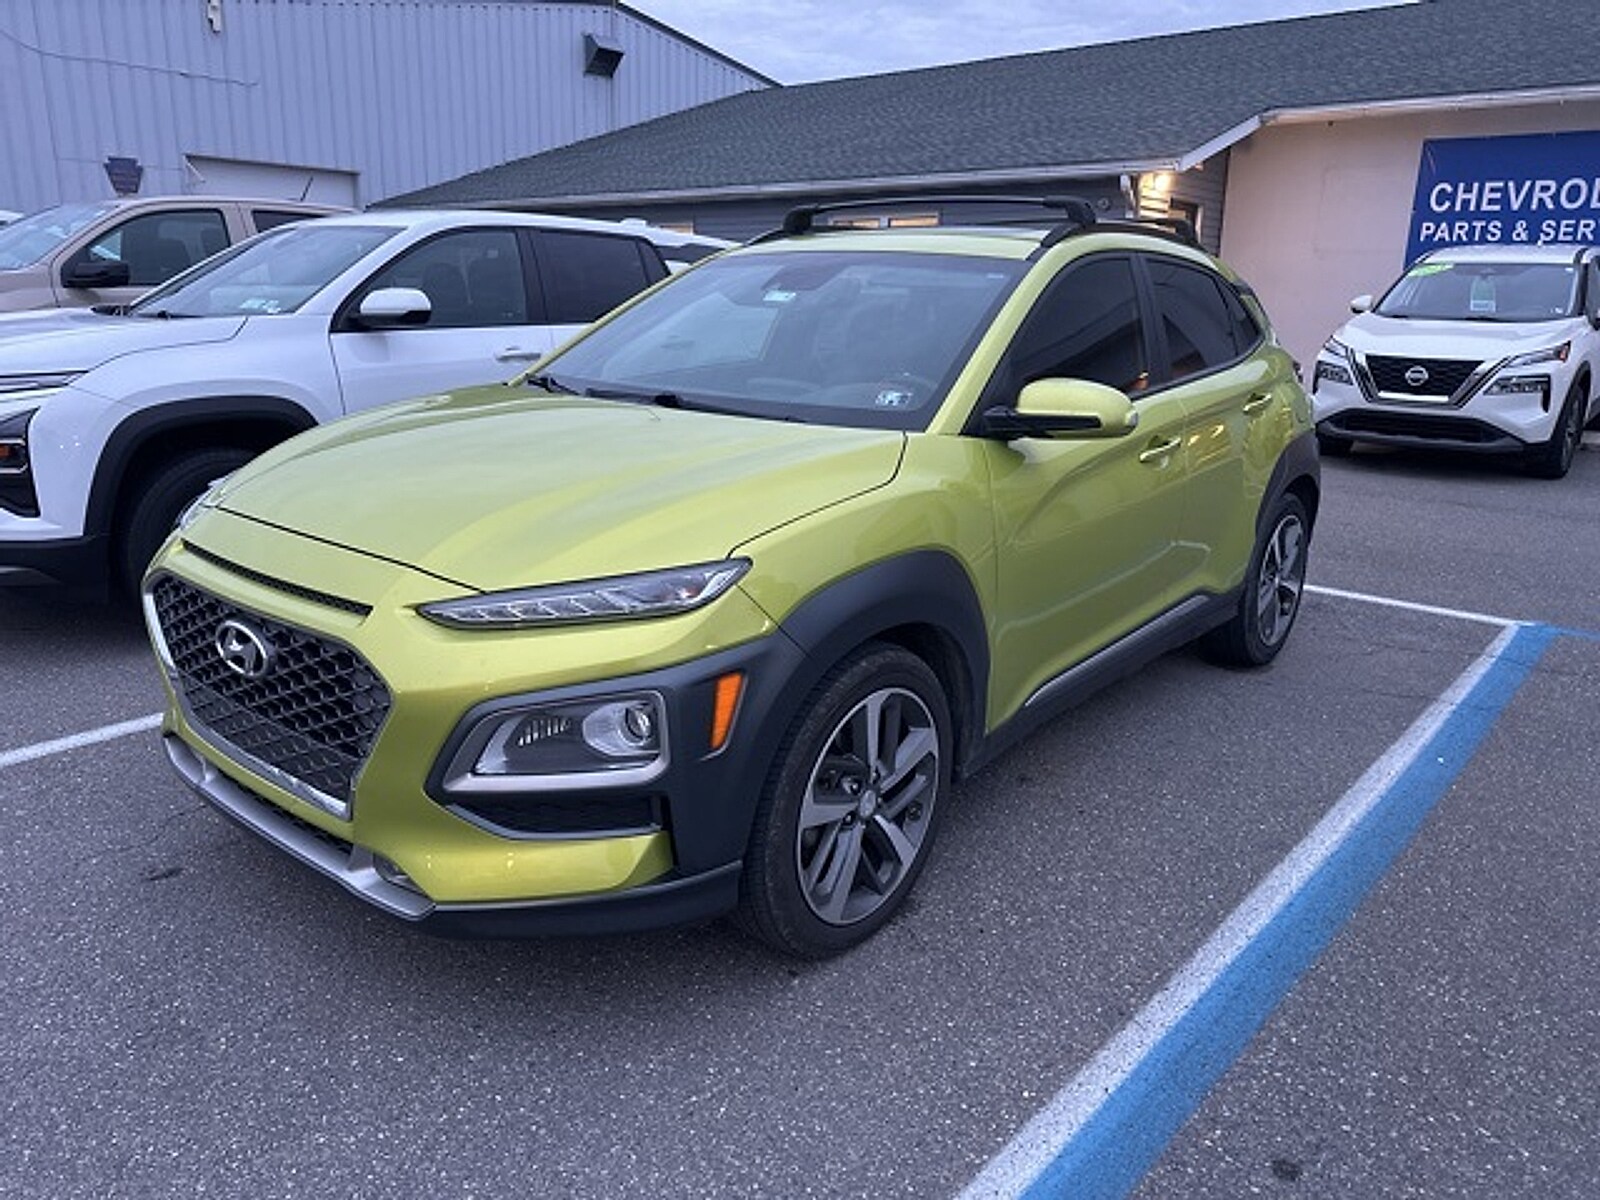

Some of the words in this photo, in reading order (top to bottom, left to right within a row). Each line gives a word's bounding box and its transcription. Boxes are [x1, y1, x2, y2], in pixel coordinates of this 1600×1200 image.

[1420, 220, 1501, 242] PARTS
[1512, 220, 1529, 241] &
[1540, 219, 1600, 241] SER
